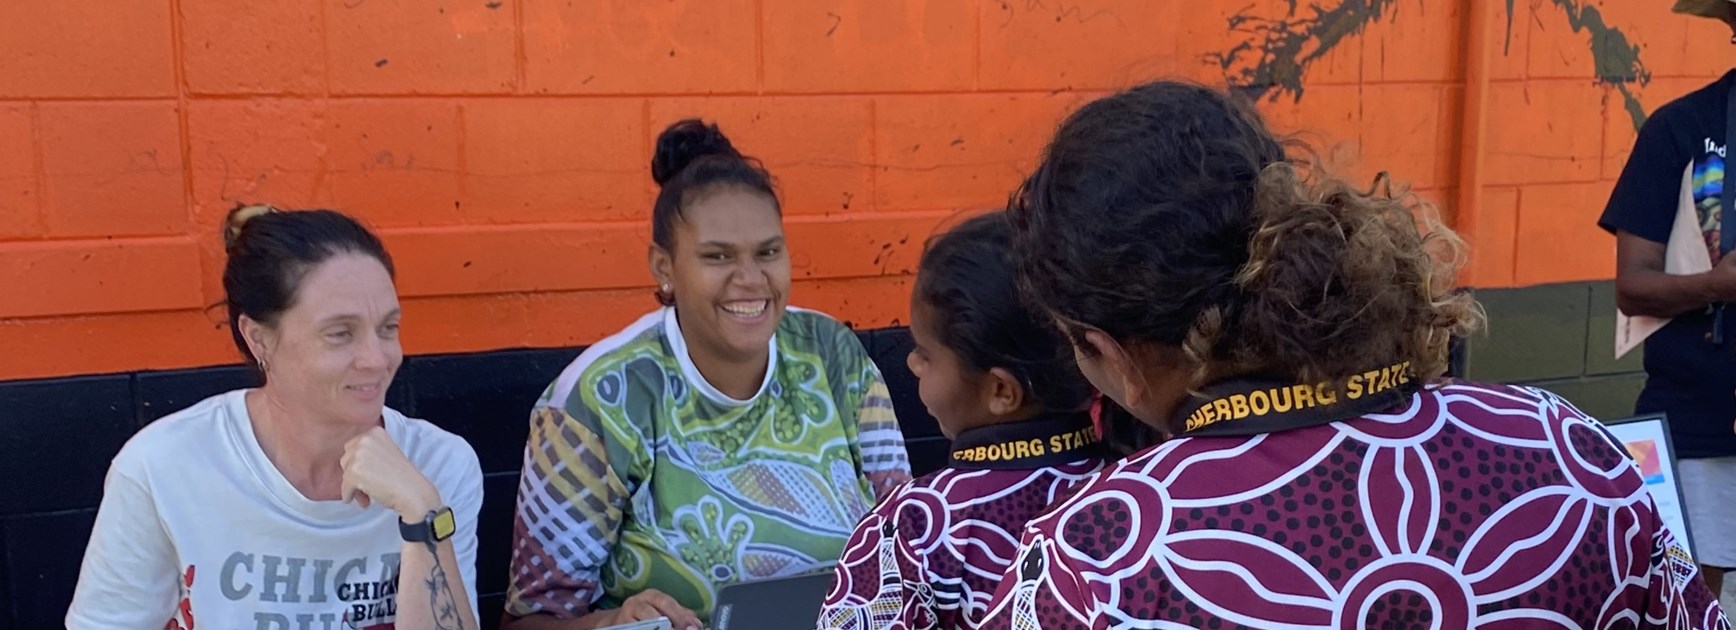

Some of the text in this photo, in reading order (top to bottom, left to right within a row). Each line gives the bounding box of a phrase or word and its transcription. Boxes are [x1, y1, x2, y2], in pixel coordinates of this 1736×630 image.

[1346, 361, 1410, 399] STATE
[953, 438, 1045, 462] ERBOURG
[219, 551, 401, 603] CHICA
